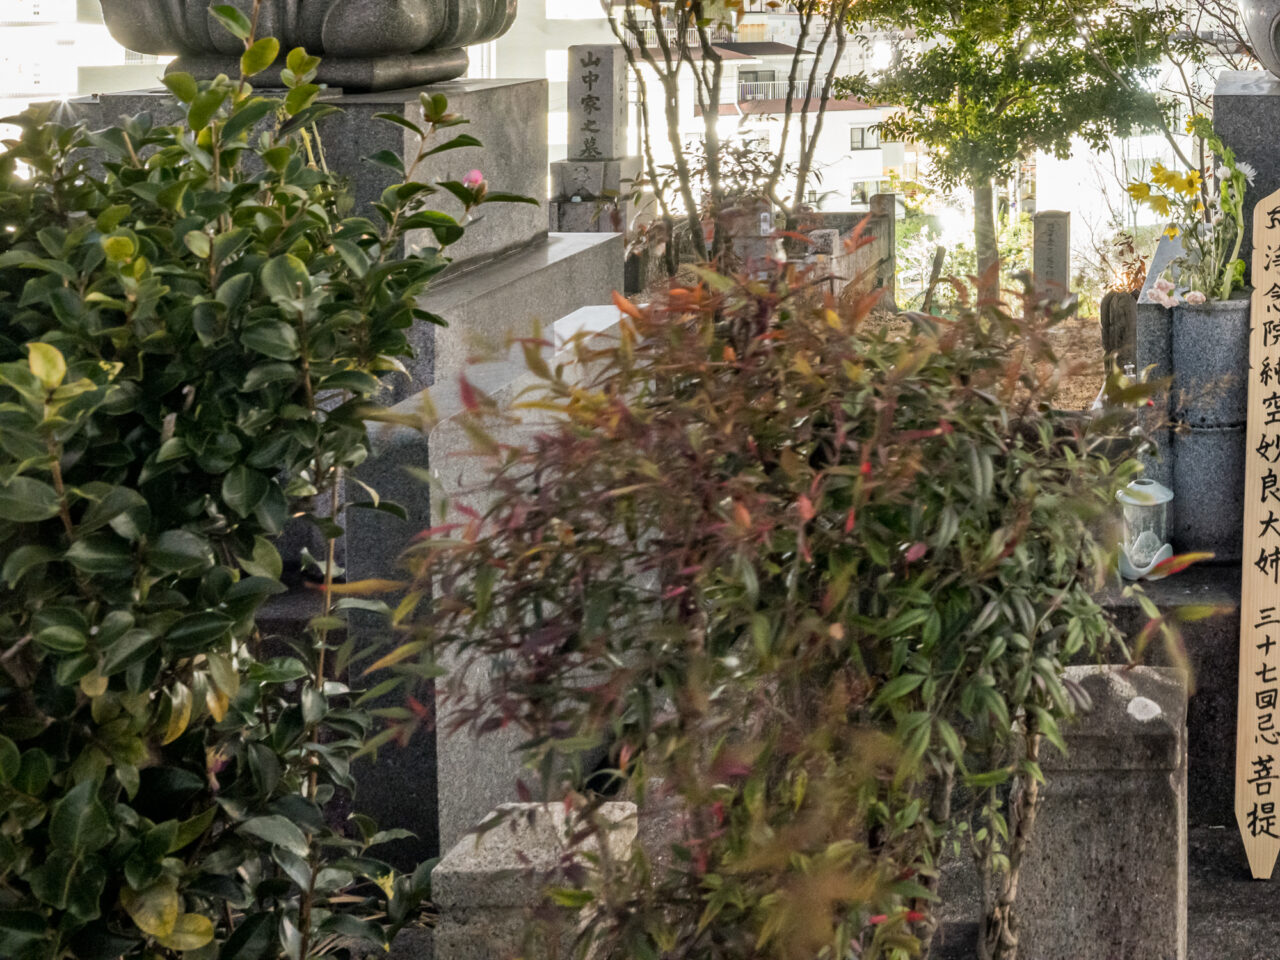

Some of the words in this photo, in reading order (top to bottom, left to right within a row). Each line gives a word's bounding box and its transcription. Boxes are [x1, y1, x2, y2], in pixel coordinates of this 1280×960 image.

[579, 51, 603, 159] 山中家之墓
